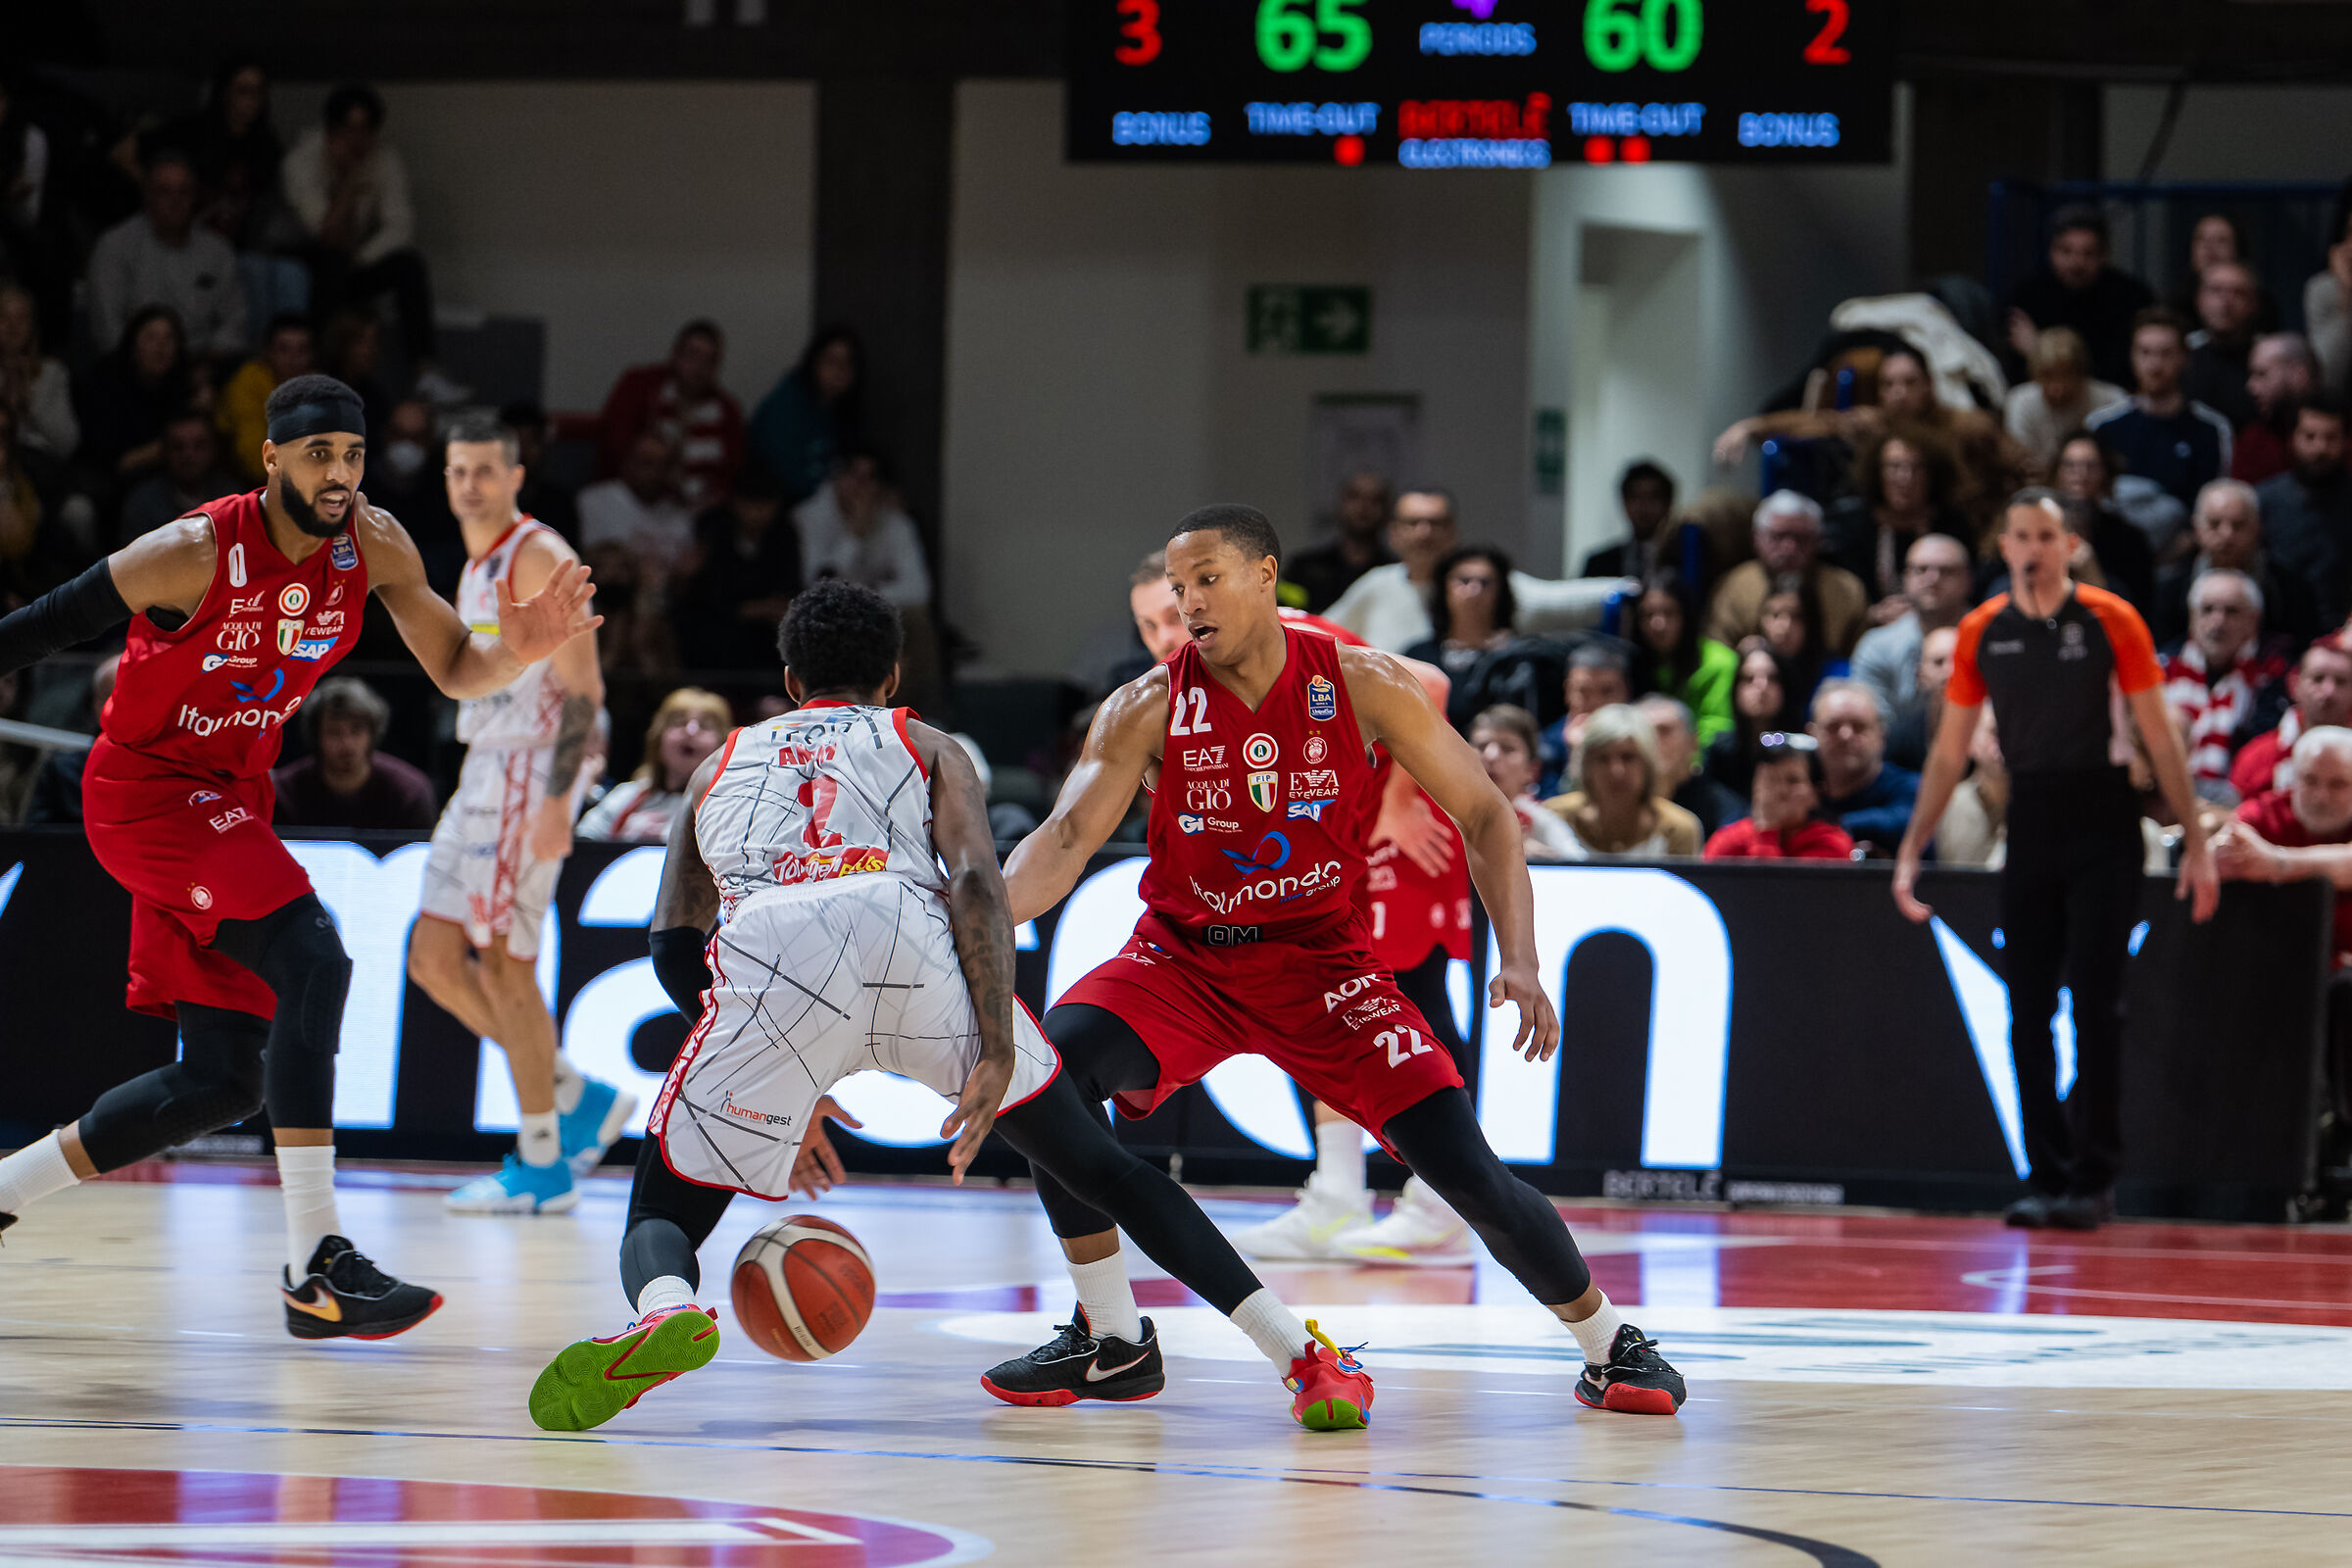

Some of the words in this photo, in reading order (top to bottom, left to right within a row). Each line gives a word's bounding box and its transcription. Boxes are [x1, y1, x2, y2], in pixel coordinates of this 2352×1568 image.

[1114, 0, 1163, 66] 3
[1254, 0, 1373, 73] 65
[1583, 0, 1704, 73] 60
[1802, 0, 1852, 65] 2
[1112, 111, 1212, 146] BONUS
[1738, 112, 1840, 147] BONUS
[228, 543, 247, 587] 0
[228, 655, 258, 665] Group
[292, 643, 329, 659] SAP
[1170, 686, 1212, 735] 22
[1183, 745, 1226, 766] EA7
[1255, 774, 1271, 783] FIP
[209, 807, 247, 831] EA7
[1206, 816, 1240, 830] Group
[1288, 804, 1320, 822] SAP
[1207, 924, 1258, 947] OM
[1373, 1024, 1434, 1068] 22
[726, 1102, 792, 1126] humangest
